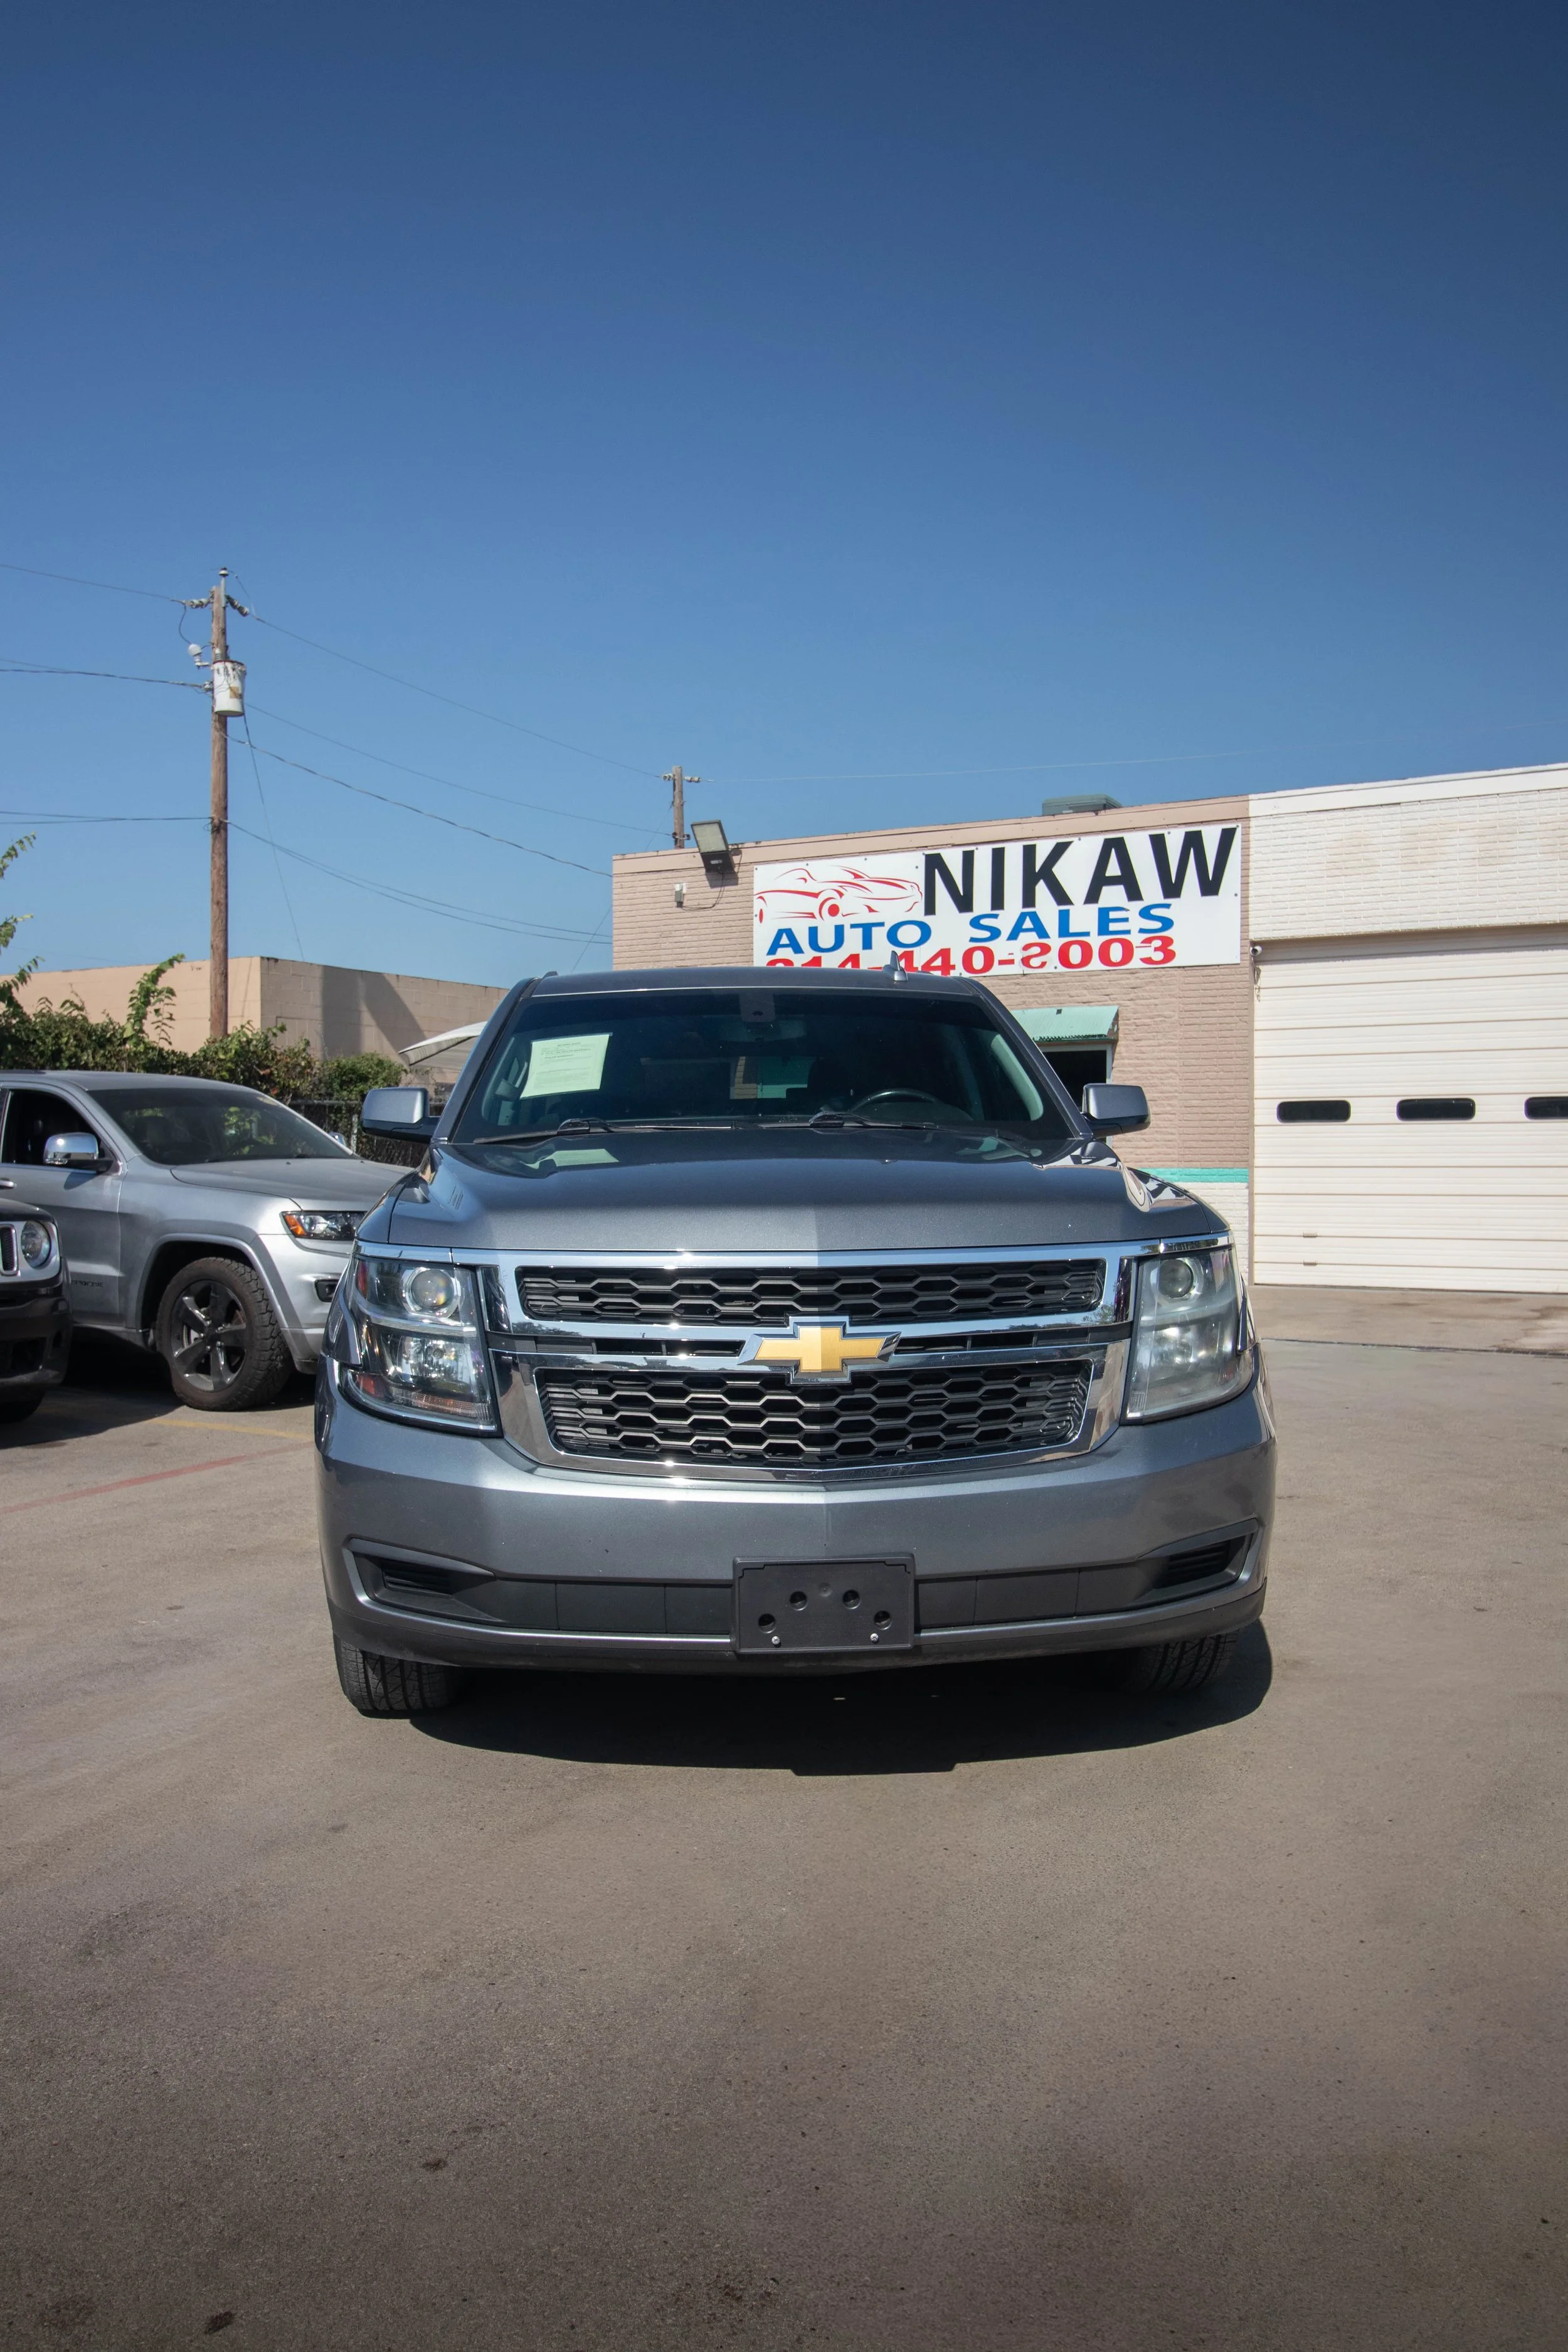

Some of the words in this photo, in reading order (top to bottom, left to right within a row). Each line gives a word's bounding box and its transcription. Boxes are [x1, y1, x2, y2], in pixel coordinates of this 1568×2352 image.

[924, 827, 1237, 916] NIKAW
[766, 920, 932, 956] AUTO
[968, 903, 1175, 943] SALES
[766, 935, 1177, 977] 4-440-2003
